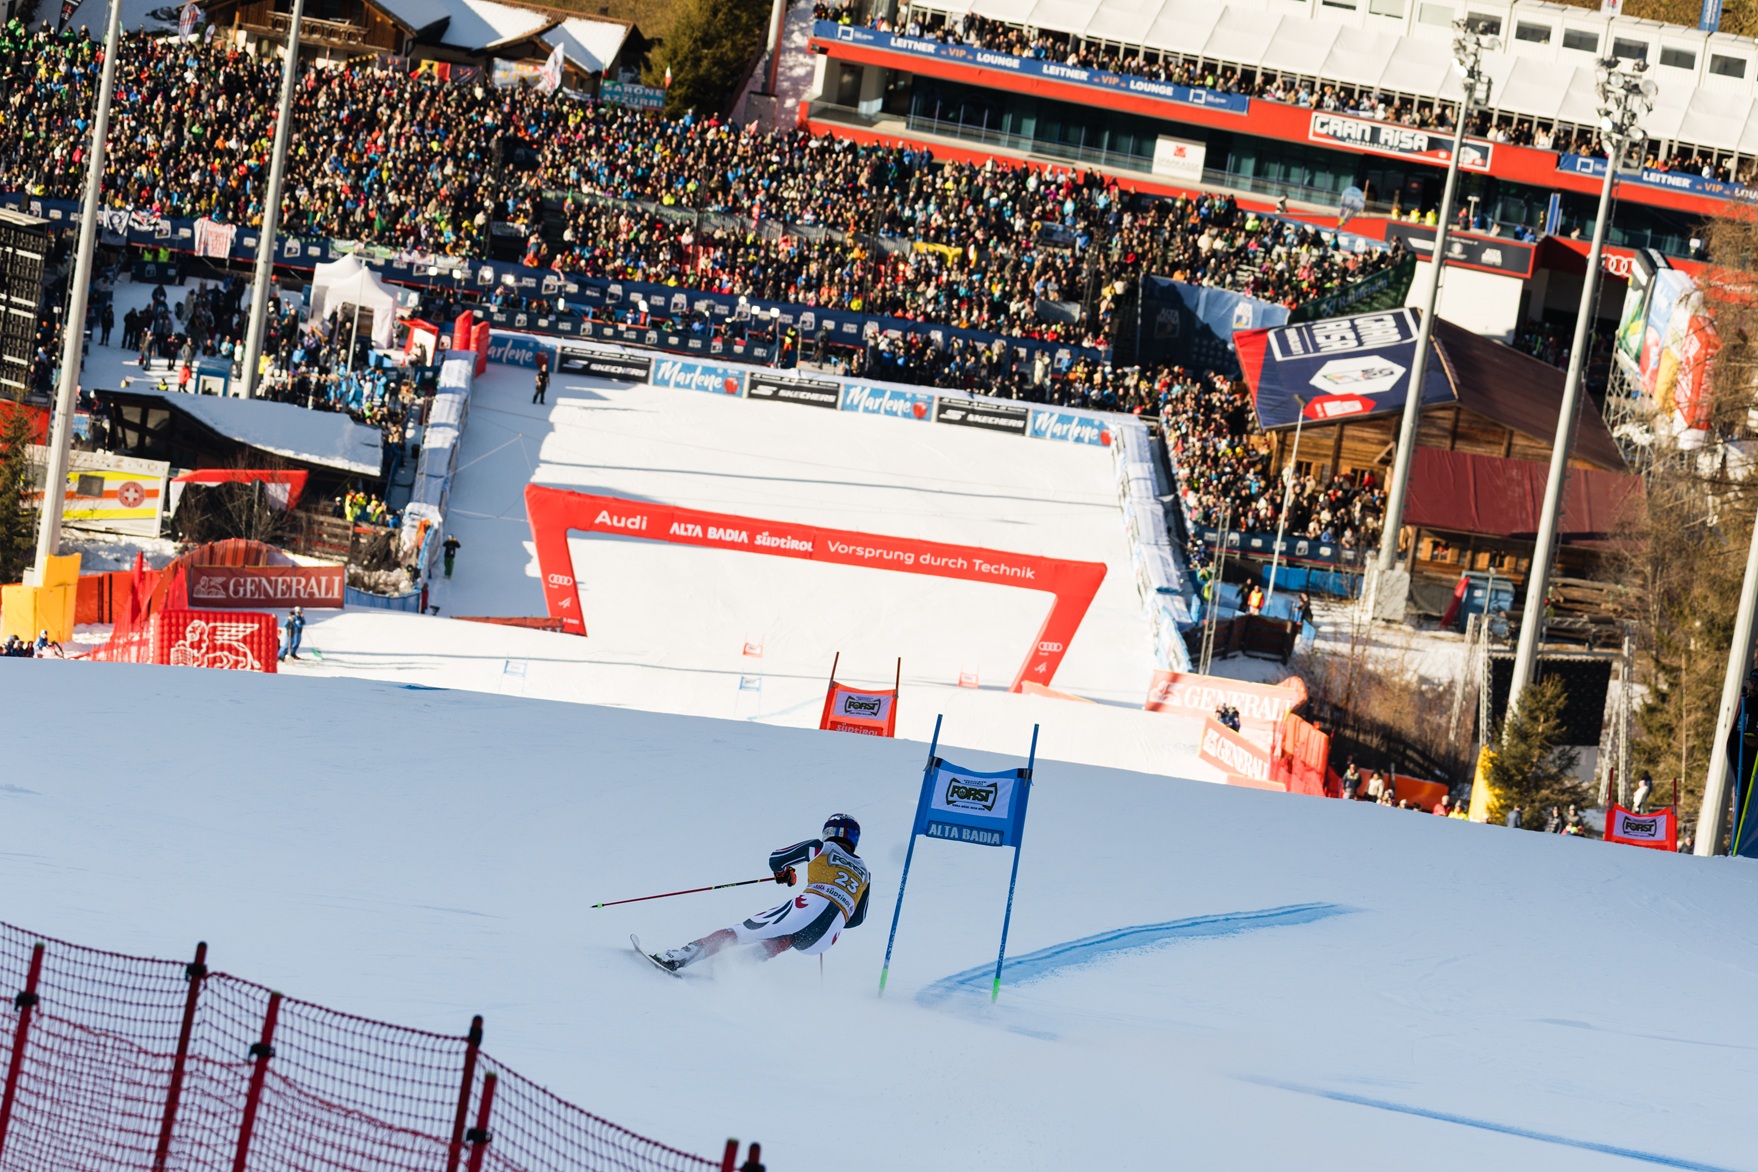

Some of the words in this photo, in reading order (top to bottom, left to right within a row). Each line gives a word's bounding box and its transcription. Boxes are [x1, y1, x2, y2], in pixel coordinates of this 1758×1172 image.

[890, 37, 936, 54] LEITNER
[948, 48, 966, 58] VIP
[977, 52, 1020, 68] LOUNGE
[1042, 64, 1088, 81] LEITNER
[1101, 75, 1119, 85] VIP
[1130, 80, 1173, 96] LOUNGE
[1314, 116, 1371, 141] GRAN
[1379, 128, 1428, 152] RISA
[1642, 171, 1691, 188] LEITNER
[1704, 182, 1723, 192] VIP
[1735, 187, 1758, 199] LOU
[487, 336, 533, 365] arlene
[590, 363, 648, 378] SKECHERS
[656, 360, 722, 388] Marlene
[778, 389, 836, 403] SKECHERS
[846, 385, 911, 415] Marlene
[966, 413, 1025, 428] SKECHERS
[1034, 412, 1099, 443] Marlene
[594, 510, 648, 530] Audi
[669, 522, 702, 537] ALTA
[707, 527, 748, 543] BADIA
[827, 540, 914, 565] Vorsprung
[919, 553, 967, 569] durch
[972, 559, 1035, 579] Technik
[229, 576, 341, 598] GENERALI
[848, 701, 878, 711] FORST
[950, 785, 993, 802] FORST
[929, 824, 958, 839] ALTA
[962, 828, 1000, 844] BADIA
[1625, 822, 1654, 832] FORST
[834, 871, 859, 894] 23
